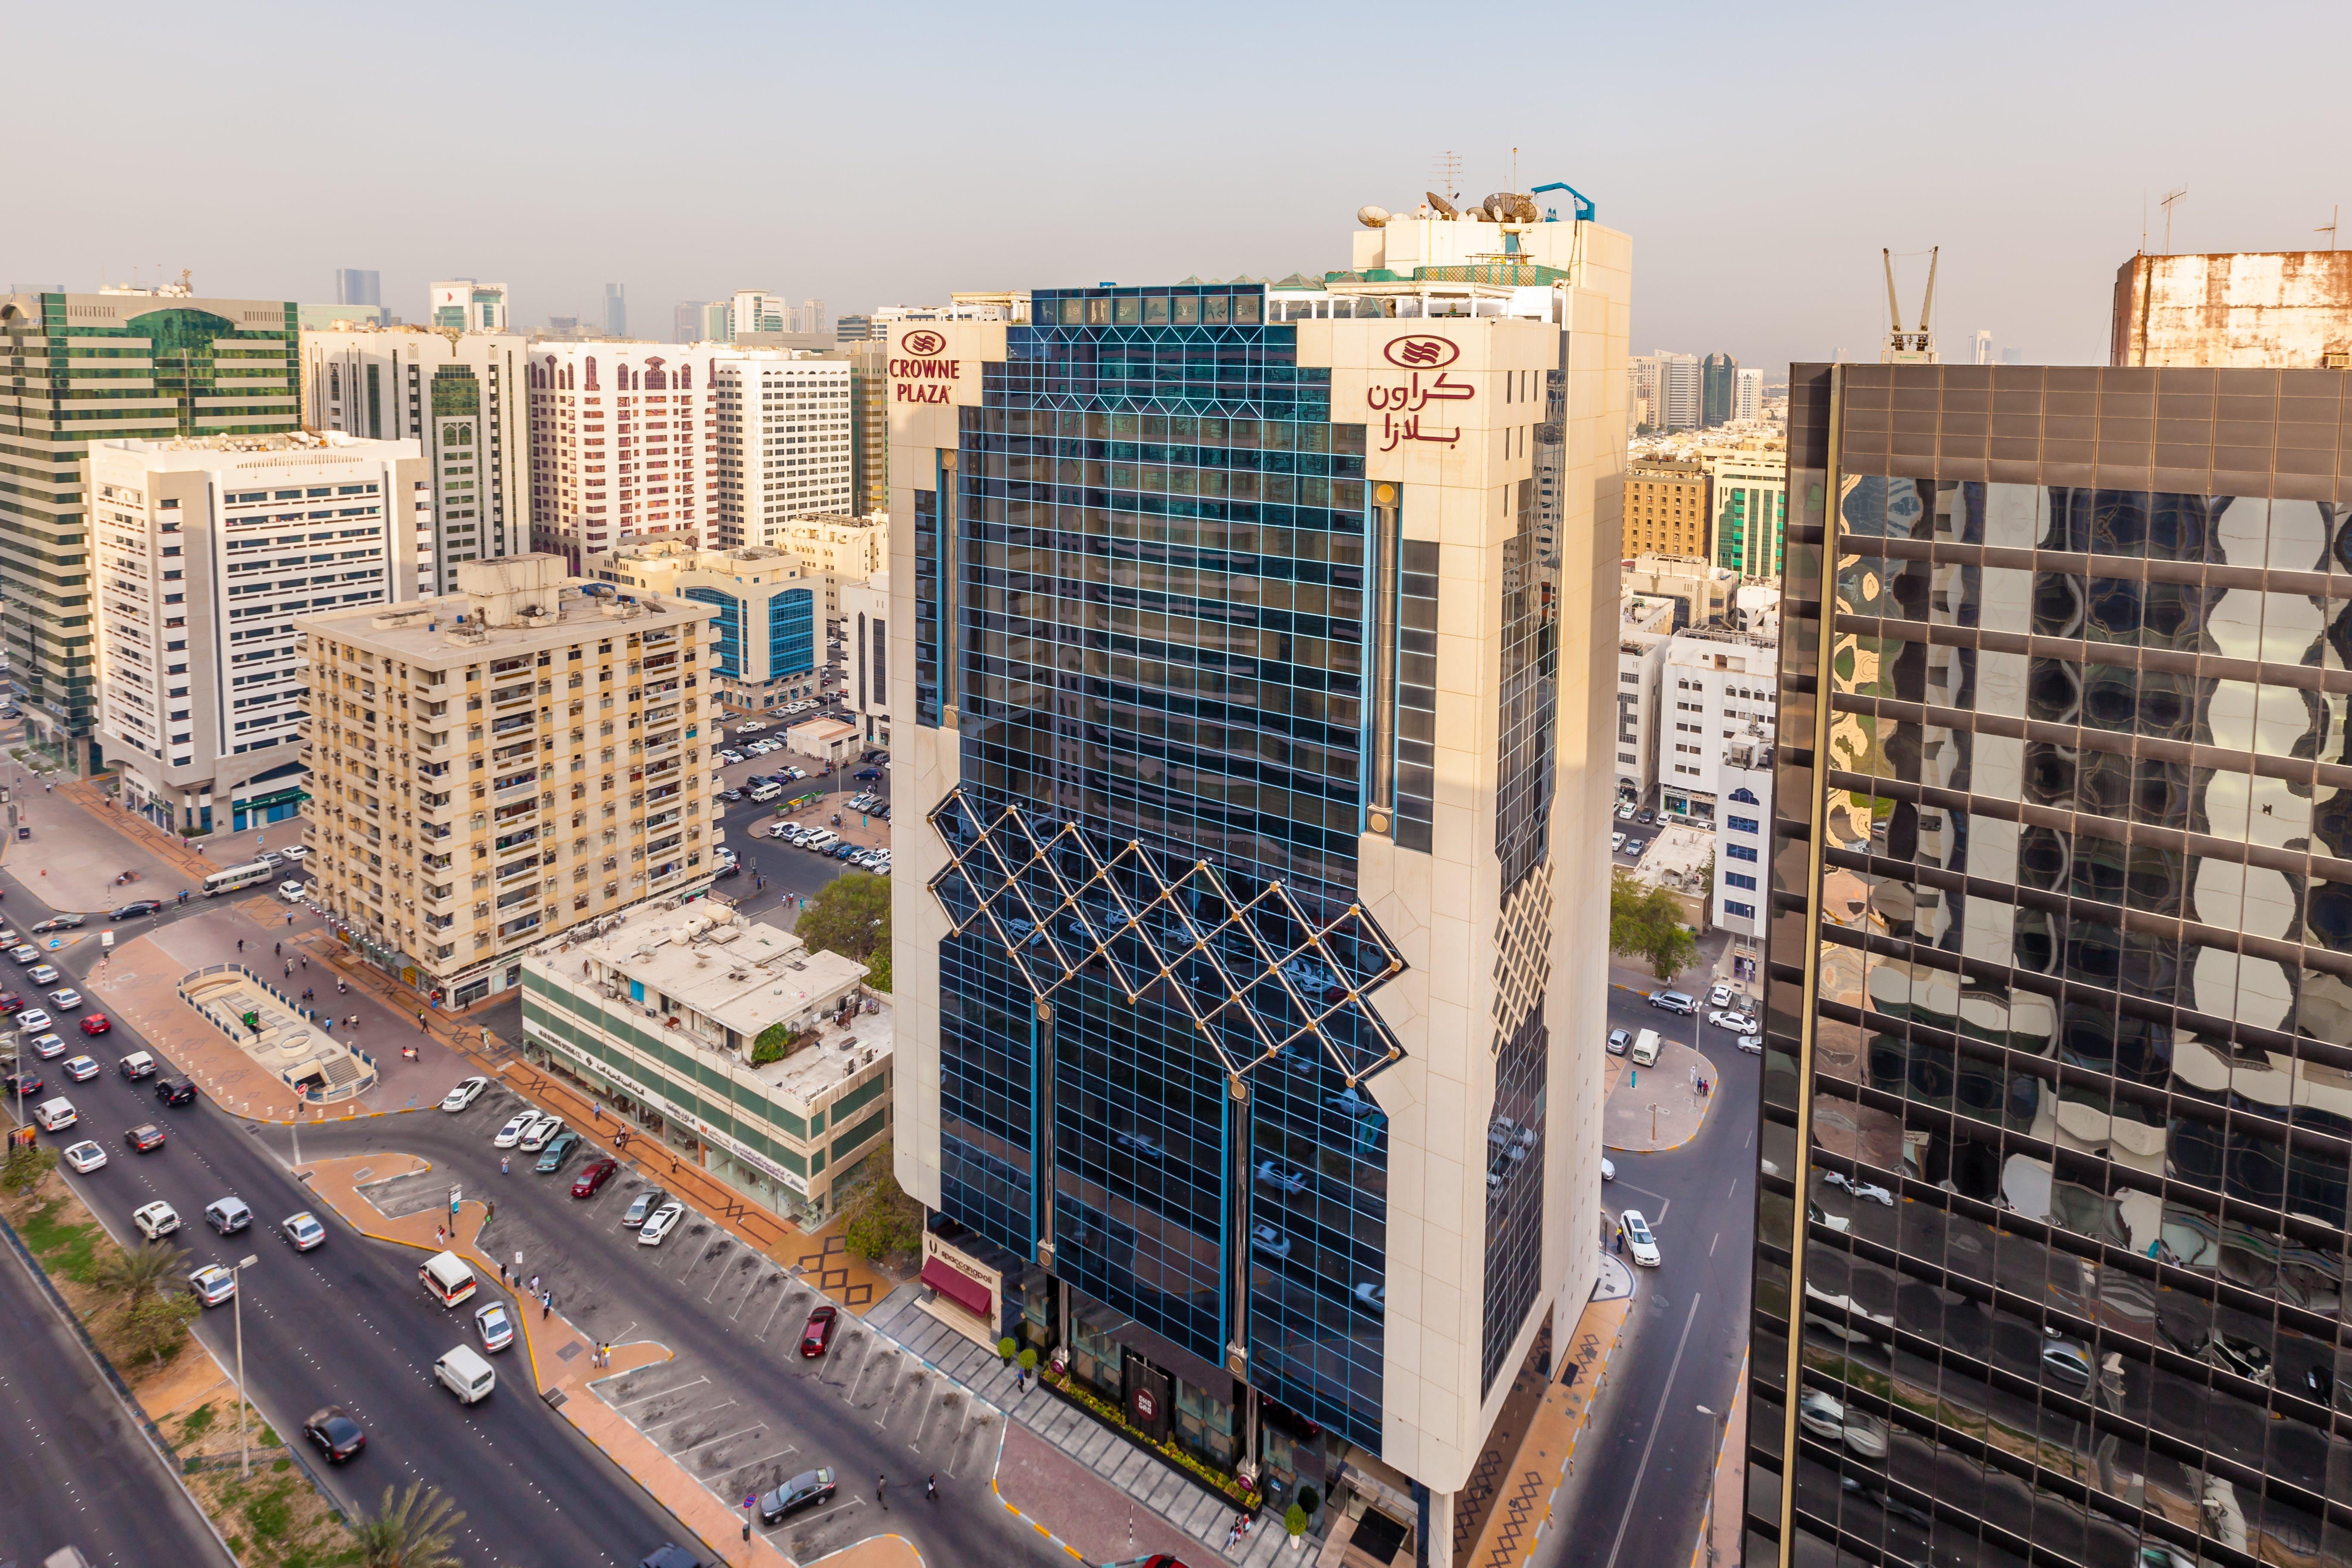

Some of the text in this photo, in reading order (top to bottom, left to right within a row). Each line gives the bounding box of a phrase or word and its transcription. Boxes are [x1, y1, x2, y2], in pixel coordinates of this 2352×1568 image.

[889, 359, 959, 379] CROWNE
[1368, 372, 1475, 411] كراون
[1380, 413, 1460, 451] بلازا
[942, 1251, 992, 1284] spaccanapoli
